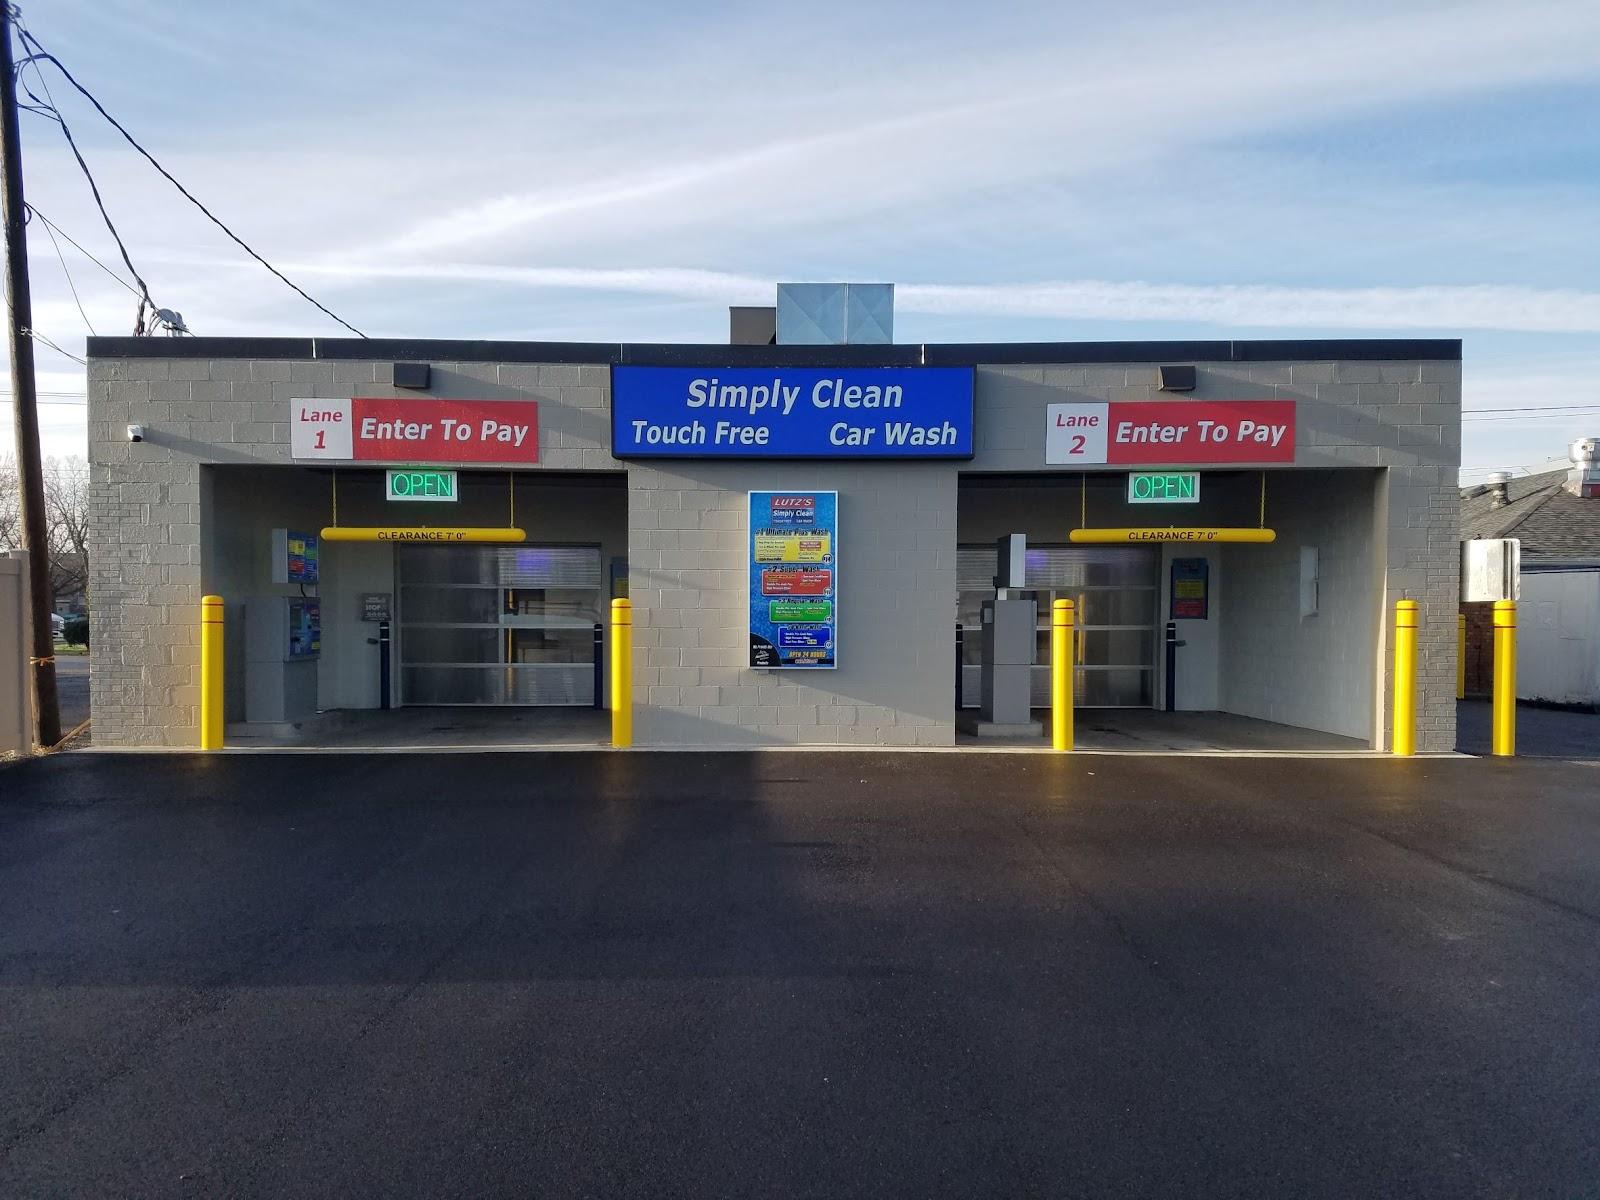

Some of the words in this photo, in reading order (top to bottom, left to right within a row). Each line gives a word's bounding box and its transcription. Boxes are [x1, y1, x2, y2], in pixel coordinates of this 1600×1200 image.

[686, 378, 800, 415] Simply
[811, 379, 904, 409] Clean
[300, 407, 343, 423] Lane
[1056, 413, 1099, 428] Lane
[313, 430, 327, 450] 1
[360, 417, 433, 441] Enter
[440, 419, 472, 441] To
[480, 420, 529, 447] Pay
[632, 420, 706, 444] Touch
[714, 421, 770, 445] Free
[829, 422, 876, 446] Car
[884, 421, 958, 446] Wash
[1115, 421, 1189, 443] Enter
[1197, 420, 1229, 443] To
[1237, 420, 1287, 447] Pay
[1068, 434, 1086, 455] 2
[393, 473, 452, 496] OPEN
[1134, 475, 1192, 498] OPEN
[774, 498, 813, 506] LUTZ'S
[773, 509, 795, 517] Simply
[795, 509, 814, 517] Clean
[377, 531, 444, 540] CLEARANCE
[1128, 531, 1194, 540] CLEARANCE
